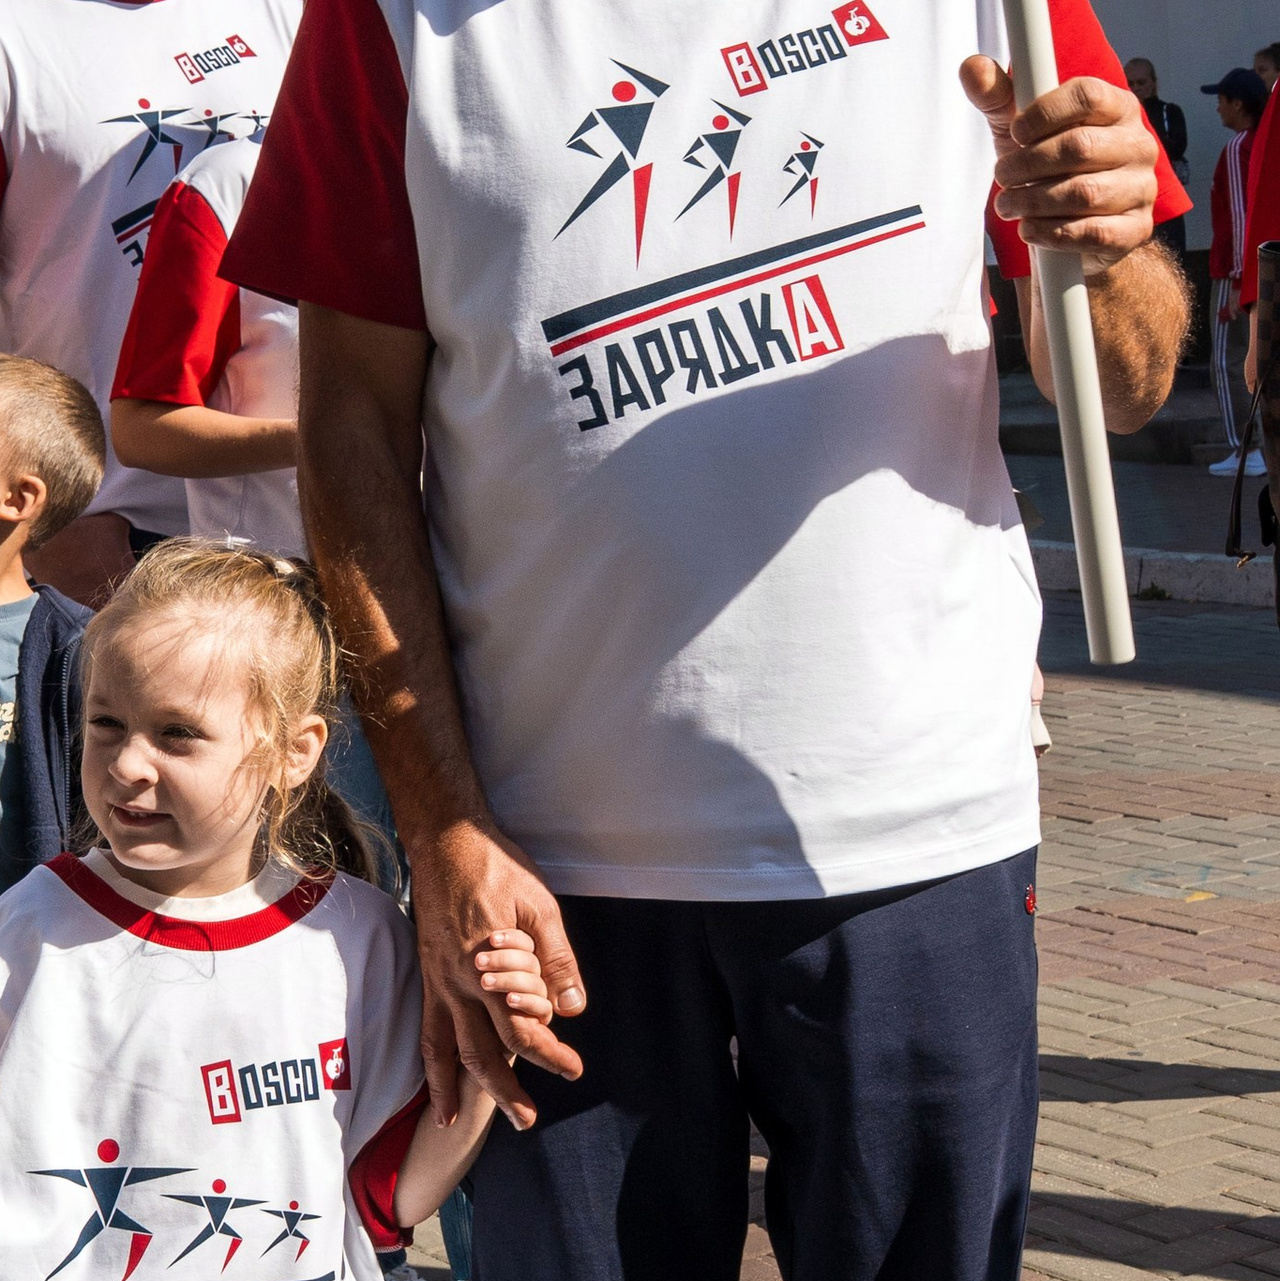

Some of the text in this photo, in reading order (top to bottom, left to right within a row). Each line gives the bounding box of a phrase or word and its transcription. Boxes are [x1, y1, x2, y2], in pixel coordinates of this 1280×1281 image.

[174, 45, 241, 85] BOSCO
[720, 23, 848, 97] BOSCO
[558, 274, 845, 432] ЗАРЯДКА
[200, 1058, 320, 1125] BOSCO
